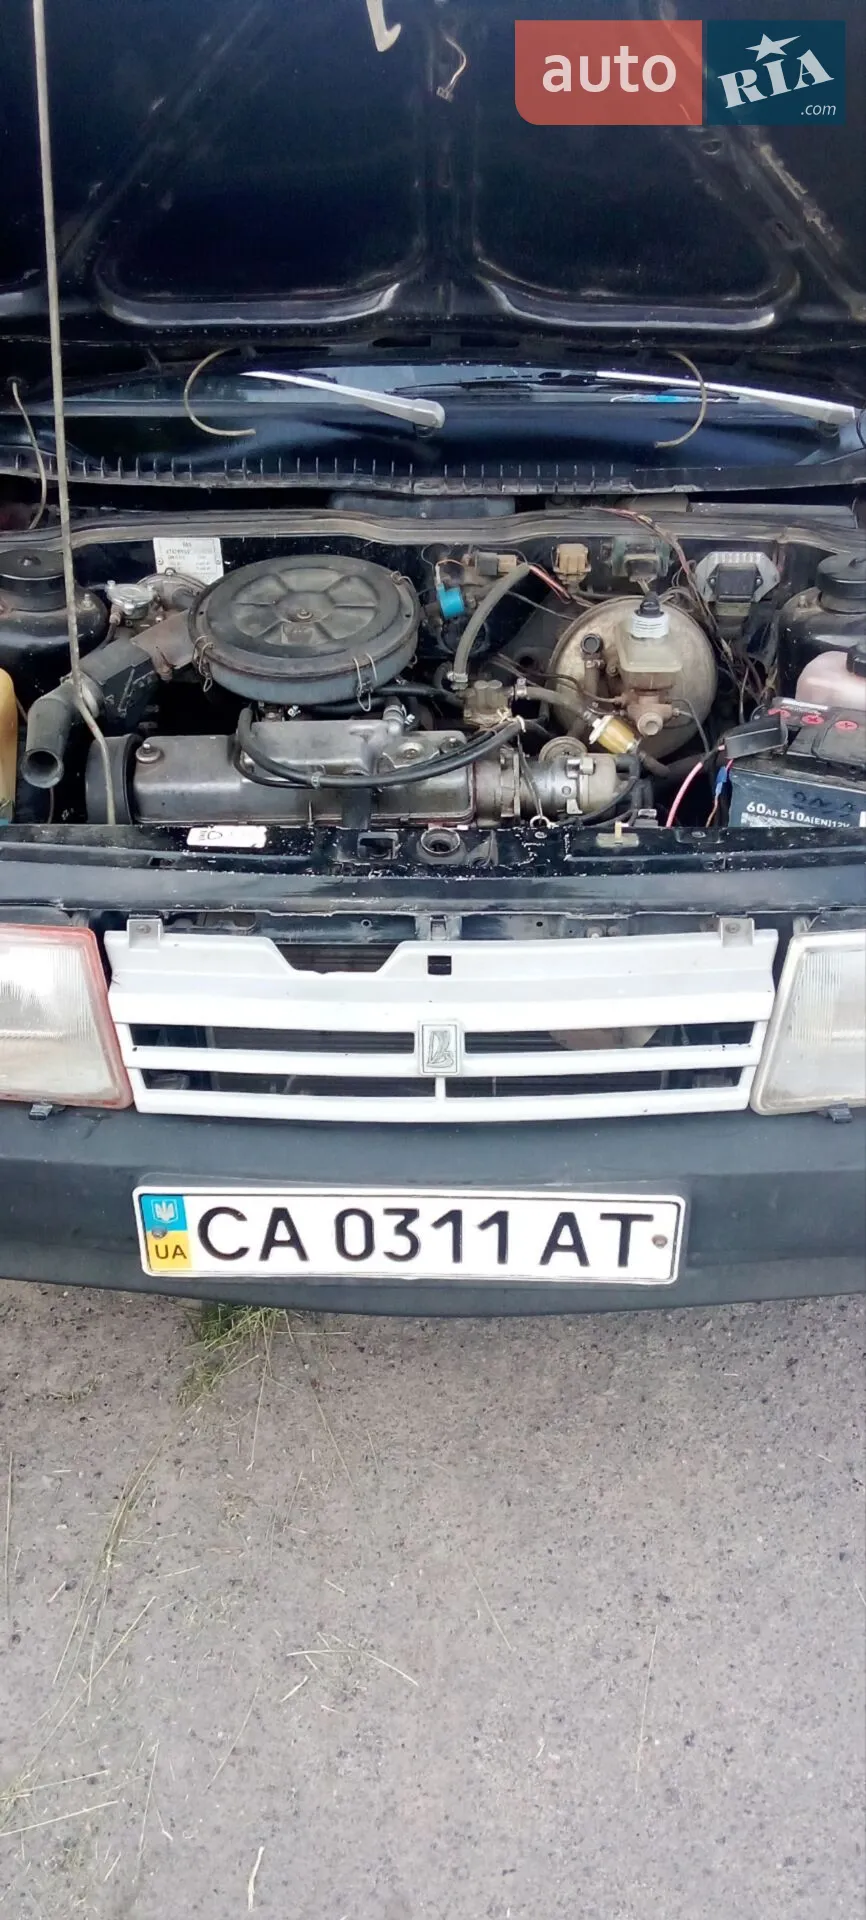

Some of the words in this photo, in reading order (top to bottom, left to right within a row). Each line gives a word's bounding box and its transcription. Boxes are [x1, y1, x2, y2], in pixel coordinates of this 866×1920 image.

[746, 801, 778, 817] 60Ah
[197, 1206, 310, 1262] CA
[334, 1208, 509, 1265] 0311
[539, 1211, 654, 1268] AT
[154, 1244, 187, 1260] UA
